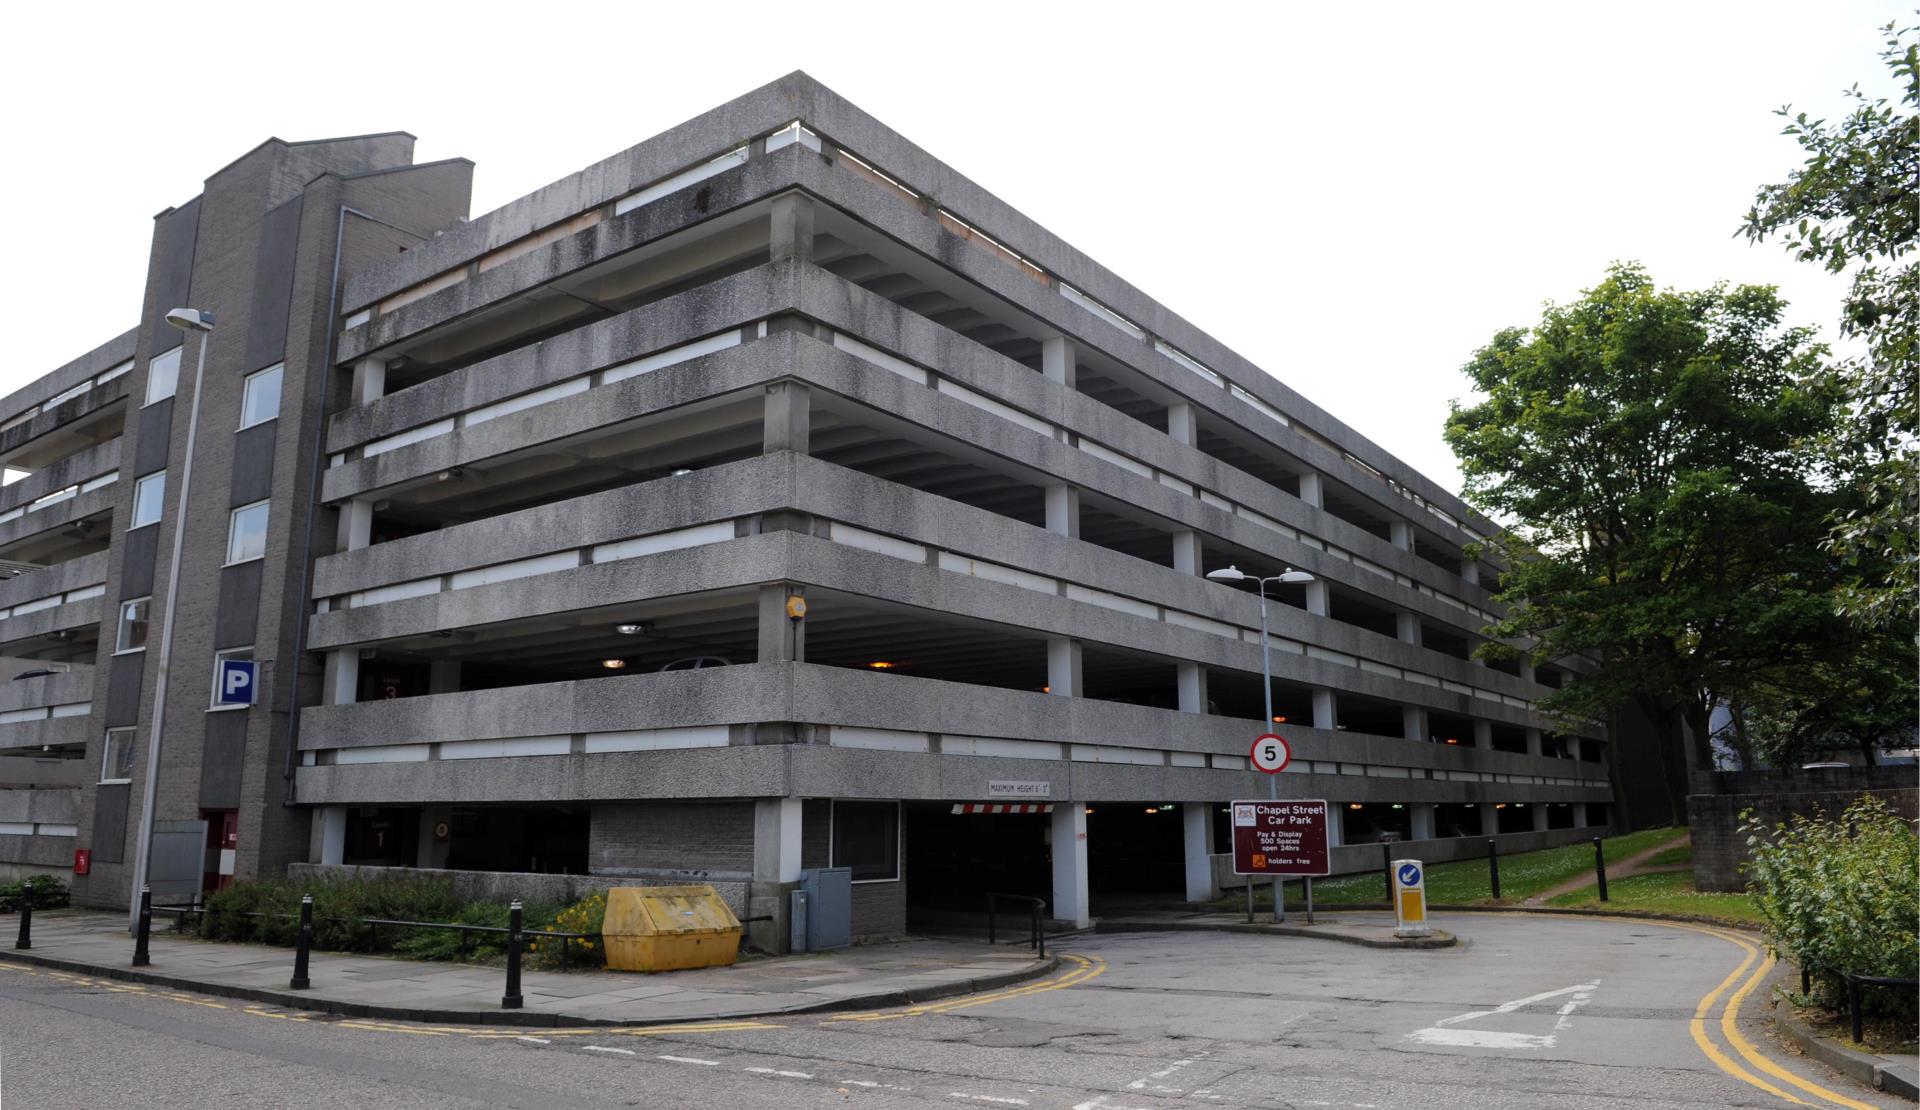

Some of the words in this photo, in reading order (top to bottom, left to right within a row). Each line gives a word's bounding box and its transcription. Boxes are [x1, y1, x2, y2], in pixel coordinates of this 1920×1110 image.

[226, 669, 250, 695] P
[1264, 745, 1277, 762] 5
[990, 784, 1015, 793] MAXIMUM
[1017, 784, 1035, 793] HEIGHT
[1256, 805, 1290, 816] Chapel
[1292, 805, 1324, 815] Street
[1268, 816, 1285, 825] Car
[1289, 815, 1312, 825] Park
[377, 831, 384, 848] 1
